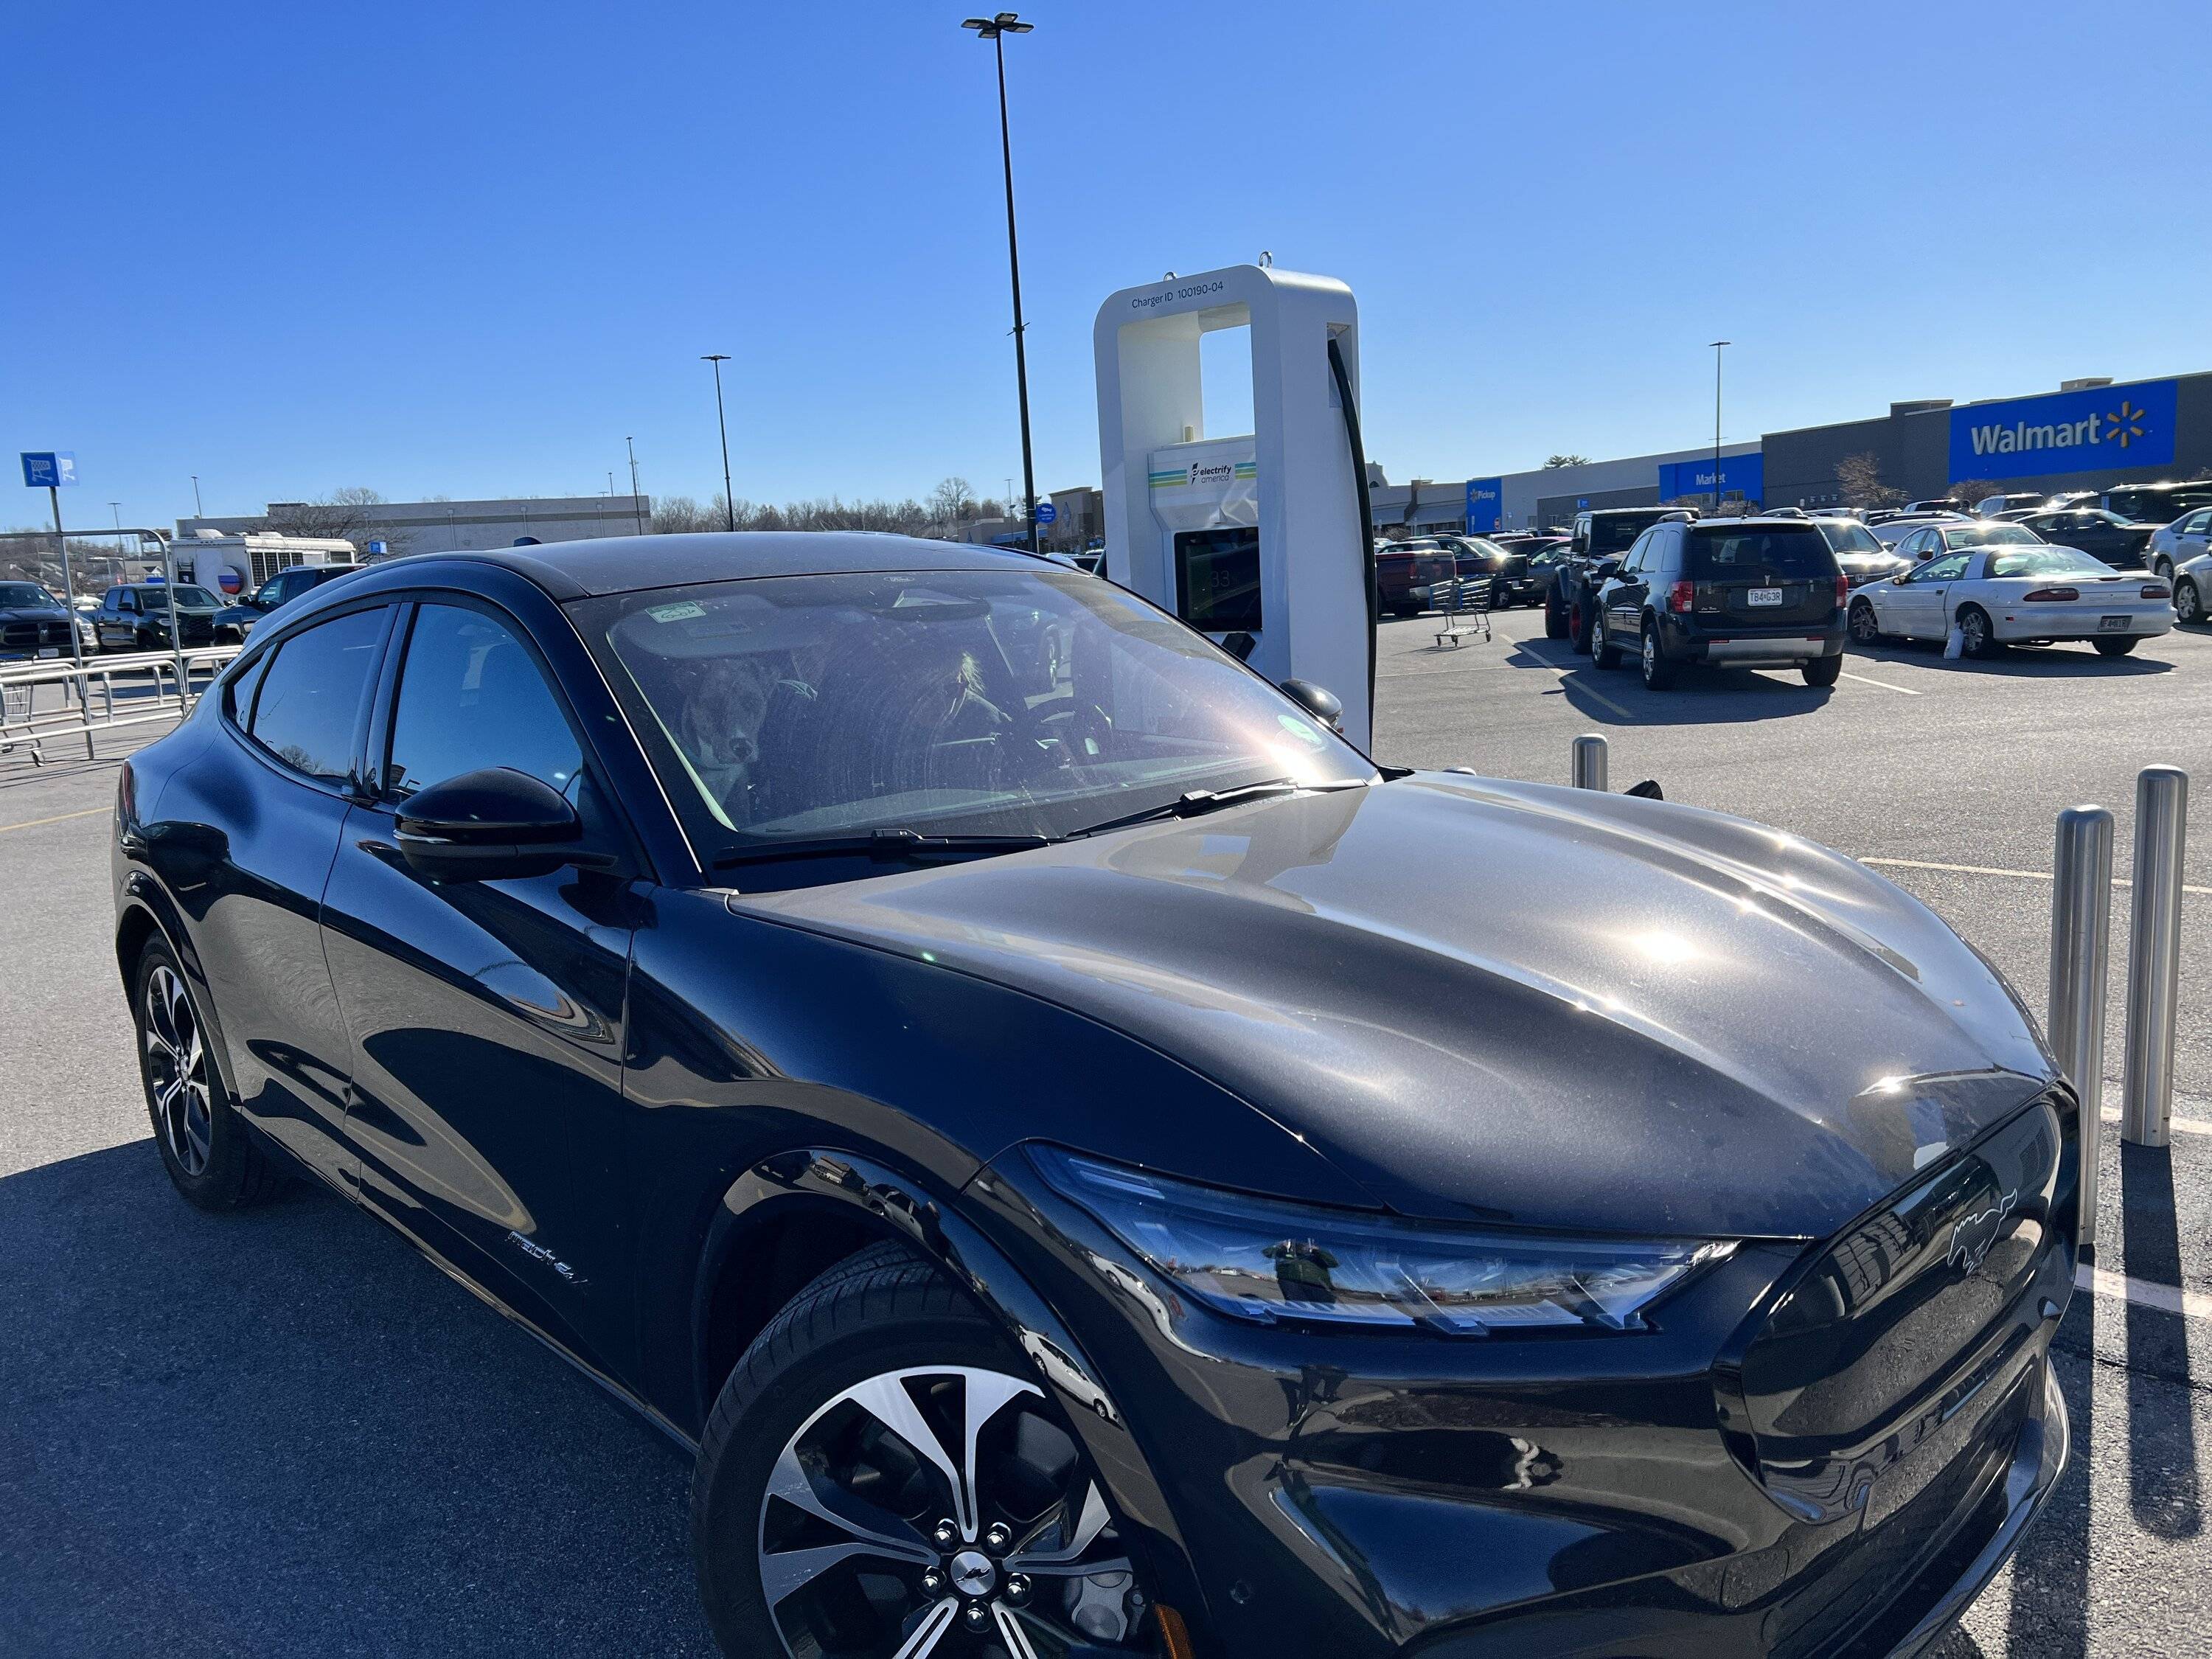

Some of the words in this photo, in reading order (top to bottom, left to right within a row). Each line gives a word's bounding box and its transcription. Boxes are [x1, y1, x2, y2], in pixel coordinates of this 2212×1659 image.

[1132, 296, 1164, 308] Charger
[1164, 292, 1173, 302] ID
[1178, 281, 1224, 299] 100190-04
[1971, 413, 2101, 456] Walmart
[1200, 465, 1232, 476] electrify
[1200, 475, 1230, 484] america
[1696, 472, 1726, 485] Market
[1478, 490, 1496, 501] Pickup
